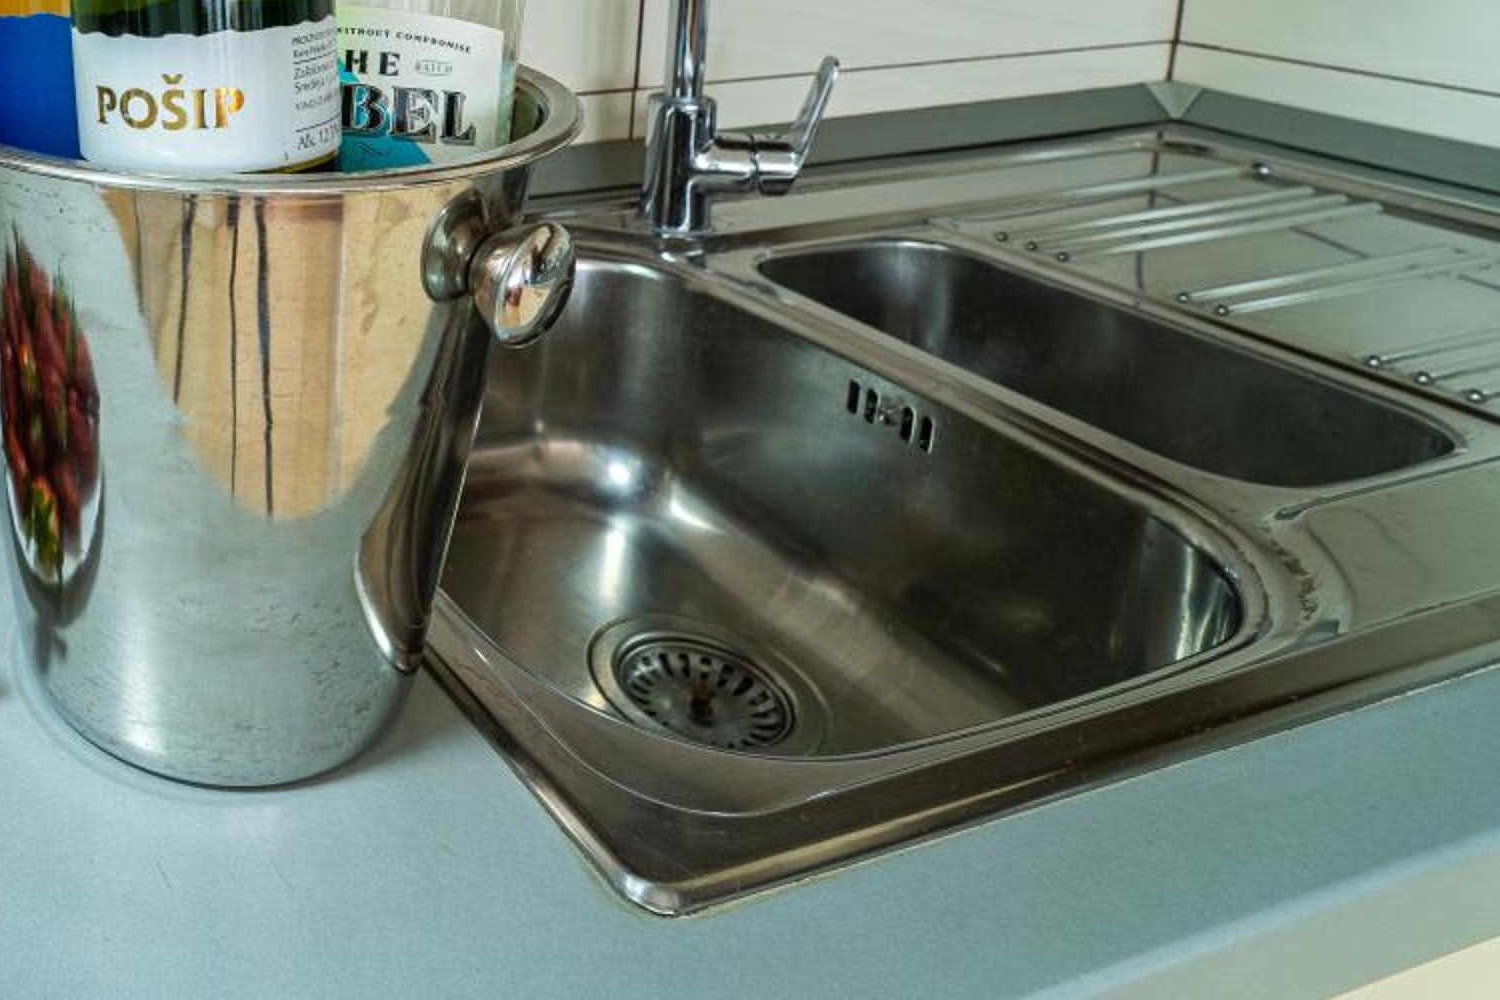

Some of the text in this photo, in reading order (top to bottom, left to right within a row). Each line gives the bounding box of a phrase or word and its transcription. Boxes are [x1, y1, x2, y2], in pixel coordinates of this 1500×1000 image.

[344, 49, 401, 77] HE
[395, 31, 472, 54] COMPROMISE
[95, 73, 246, 132] POŠIP
[341, 82, 478, 147] BEL
